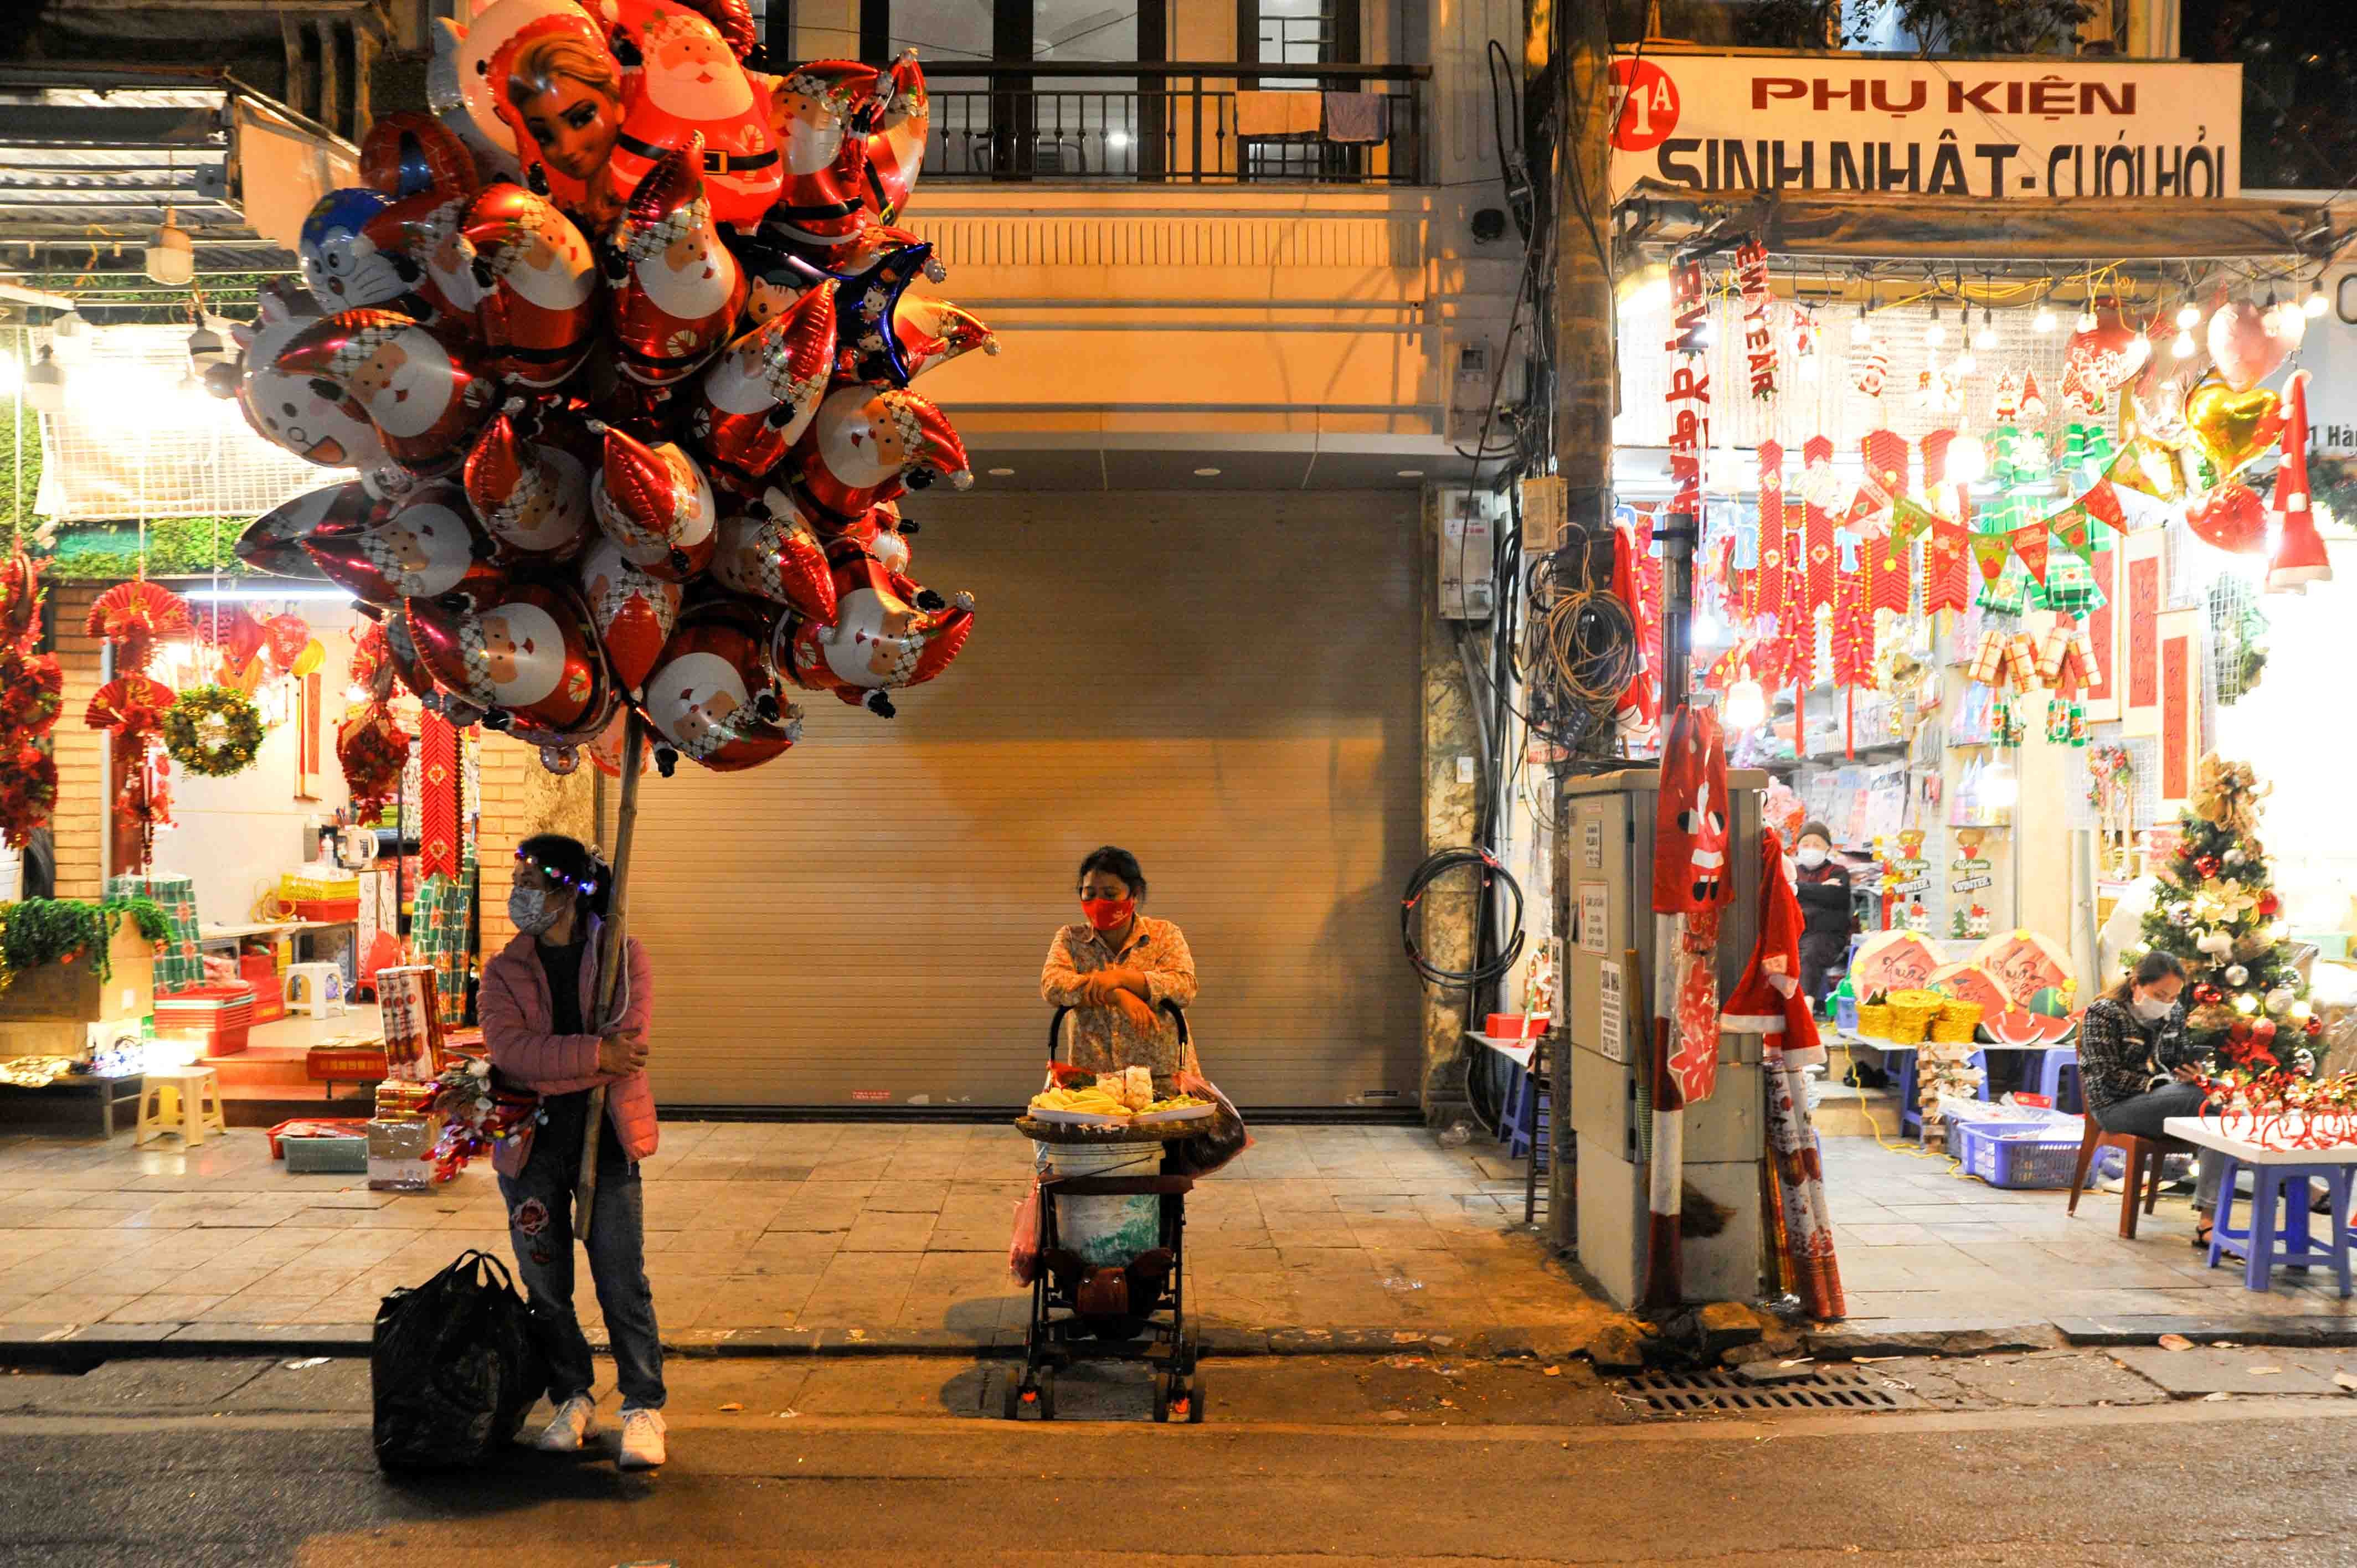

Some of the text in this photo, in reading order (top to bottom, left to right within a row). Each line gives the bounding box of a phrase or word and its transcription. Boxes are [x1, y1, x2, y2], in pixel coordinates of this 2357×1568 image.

[1752, 74, 2137, 120] PHỤ KIỆN
[1657, 138, 1814, 191] SINH
[2047, 129, 2145, 198] CƯỚI
[2155, 125, 2225, 198] HỎI
[1743, 305, 1775, 395] YEAR
[2328, 422, 2357, 447] Hà
